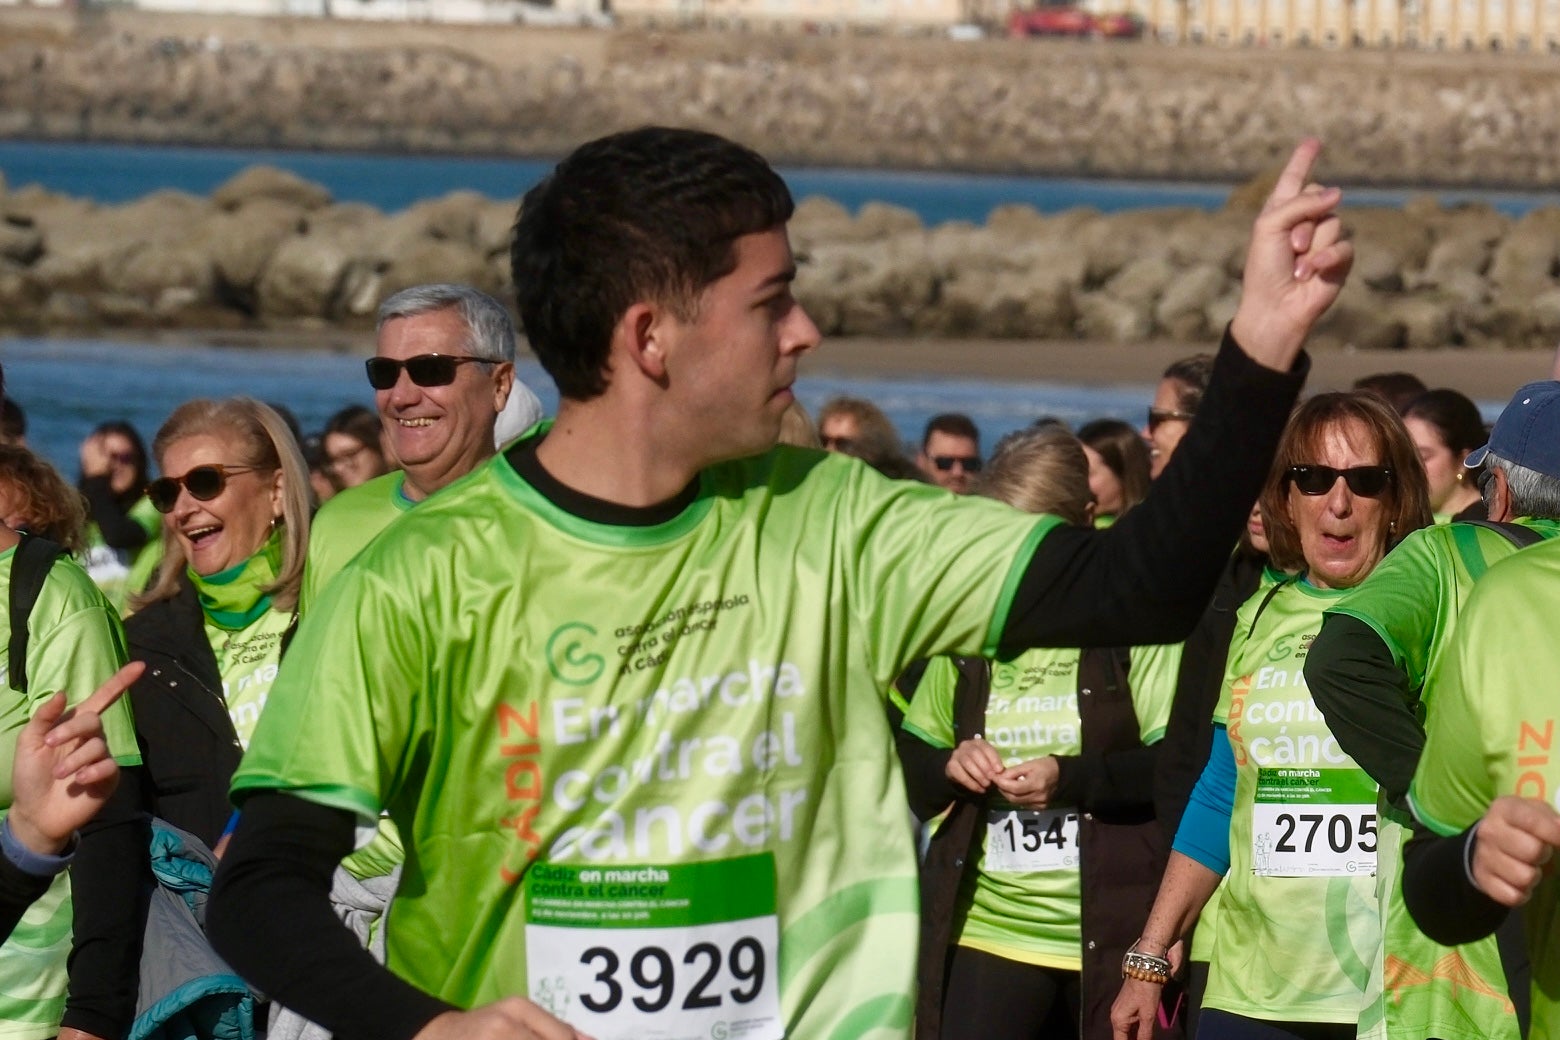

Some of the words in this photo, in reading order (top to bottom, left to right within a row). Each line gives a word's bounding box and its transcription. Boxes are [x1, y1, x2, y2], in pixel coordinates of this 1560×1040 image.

[1256, 666, 1288, 690] En
[1016, 692, 1079, 714] marc
[1246, 697, 1325, 725] cont
[553, 696, 620, 745] En
[752, 711, 802, 771] el
[1250, 726, 1346, 766] cánc
[1278, 769, 1288, 777] en
[1289, 768, 1321, 778] marcha
[1515, 719, 1554, 801] DIZ
[1275, 813, 1377, 854] 2705
[531, 883, 584, 897] contra
[588, 883, 604, 897] el
[579, 869, 601, 883] en
[605, 867, 670, 883] marcha
[579, 936, 766, 1014] 3929
